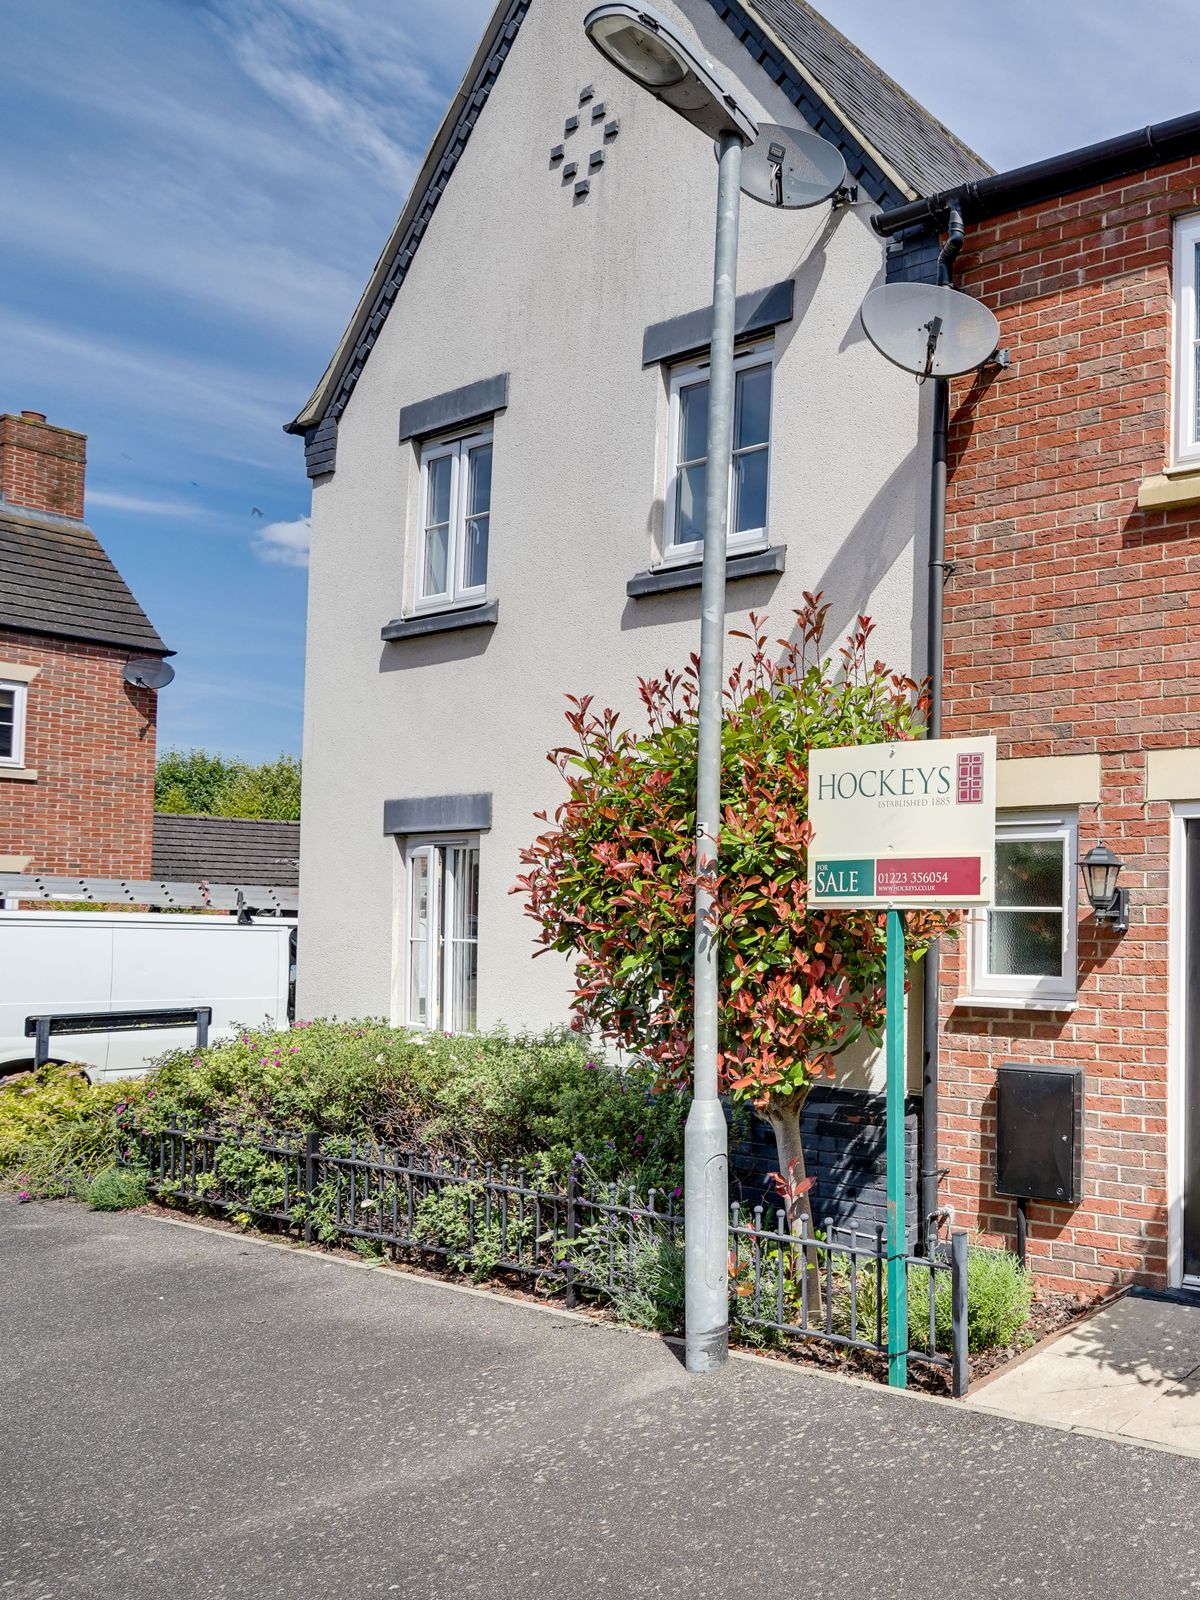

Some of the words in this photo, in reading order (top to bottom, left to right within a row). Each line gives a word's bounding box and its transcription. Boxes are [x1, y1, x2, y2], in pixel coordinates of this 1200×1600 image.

[818, 766, 951, 800] HOCKEYS
[878, 799, 928, 808] ESTABLISHED
[932, 797, 951, 806] 1885
[696, 823, 704, 838] 5
[816, 871, 859, 893] SALE
[878, 872, 907, 883] 01223
[910, 871, 948, 883] 356054
